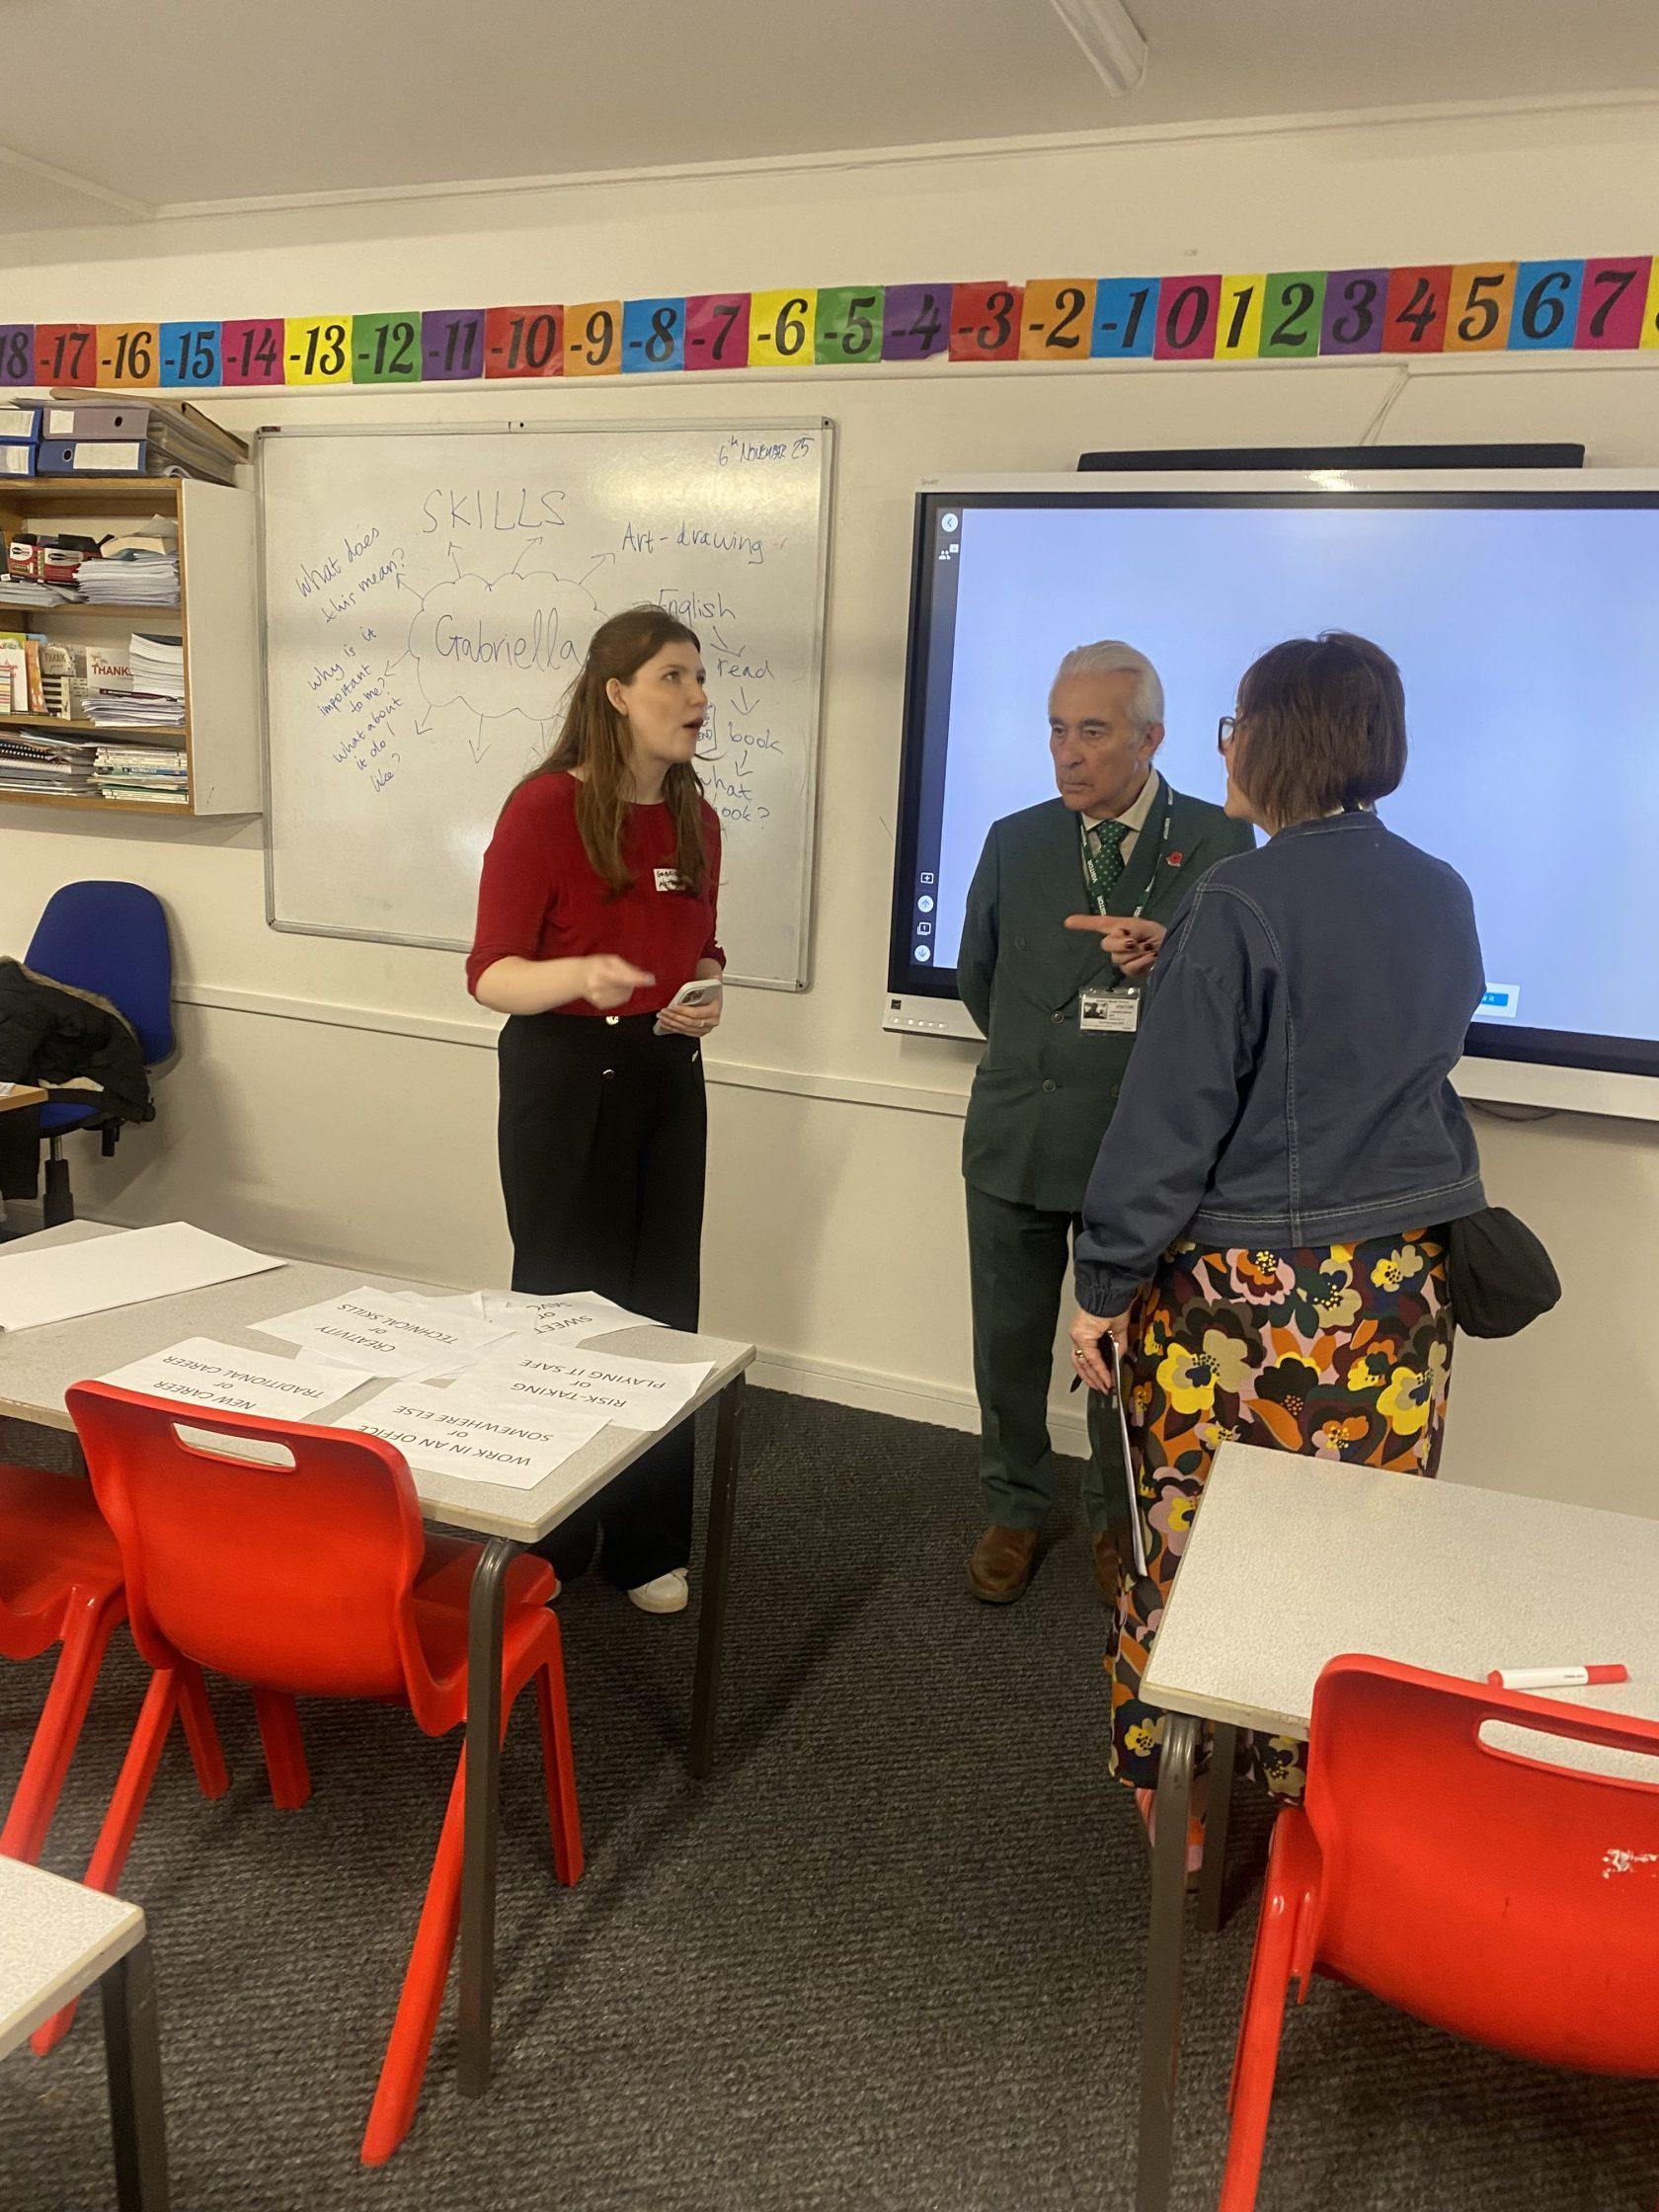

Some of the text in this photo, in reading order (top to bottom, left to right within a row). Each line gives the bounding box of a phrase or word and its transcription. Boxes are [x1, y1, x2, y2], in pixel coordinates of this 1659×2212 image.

[40, 332, 90, 379] -17
[102, 331, 152, 379] -16
[165, 330, 215, 379] -15
[226, 326, 277, 377] -14
[289, 325, 347, 376] -13
[357, 322, 415, 375] -12
[428, 318, 480, 372] -11
[491, 315, 557, 370] -10
[570, 310, 614, 365] -9
[628, 307, 677, 362] -8
[690, 304, 742, 360] -7
[756, 298, 809, 356] -6
[824, 296, 876, 354] -5
[891, 294, 942, 351] -4
[957, 290, 1015, 350] -3
[1028, 288, 1086, 348] -2
[1100, 285, 1150, 349] -1
[1165, 285, 1210, 349] 0
[1225, 285, 1255, 348] 1
[1270, 282, 1315, 347] 2
[1331, 278, 1378, 344] 3
[1395, 277, 1437, 343] 4
[1458, 274, 1505, 341] 5
[1522, 271, 1572, 339] 6
[1590, 270, 1637, 339] 7
[791, 436, 816, 459] 25
[423, 489, 566, 531] SKILLS
[344, 527, 380, 563] does
[659, 589, 737, 627] English
[344, 644, 356, 658] is
[359, 626, 377, 642] it
[435, 607, 585, 672] Gabriella
[717, 658, 775, 679] read
[317, 664, 372, 716] important
[351, 700, 363, 713] to
[367, 697, 403, 732] about
[729, 721, 783, 754] book
[355, 755, 368, 771] it
[370, 740, 386, 758] do
[315, 1325, 396, 1353] CREATIVITY
[337, 1304, 458, 1345] TECHNICAL SKILLS
[534, 1315, 592, 1334] SWEET
[162, 1355, 324, 1399] TRADITIONAL CAREER
[518, 1359, 667, 1389] PLAYING IT SAFE
[153, 1380, 257, 1410] NEW CAREER
[511, 1382, 627, 1408] RISK-TAKING
[393, 1405, 554, 1442] SOMEWHERE ELSE
[358, 1425, 531, 1466] WORK IN AN OFFICE
